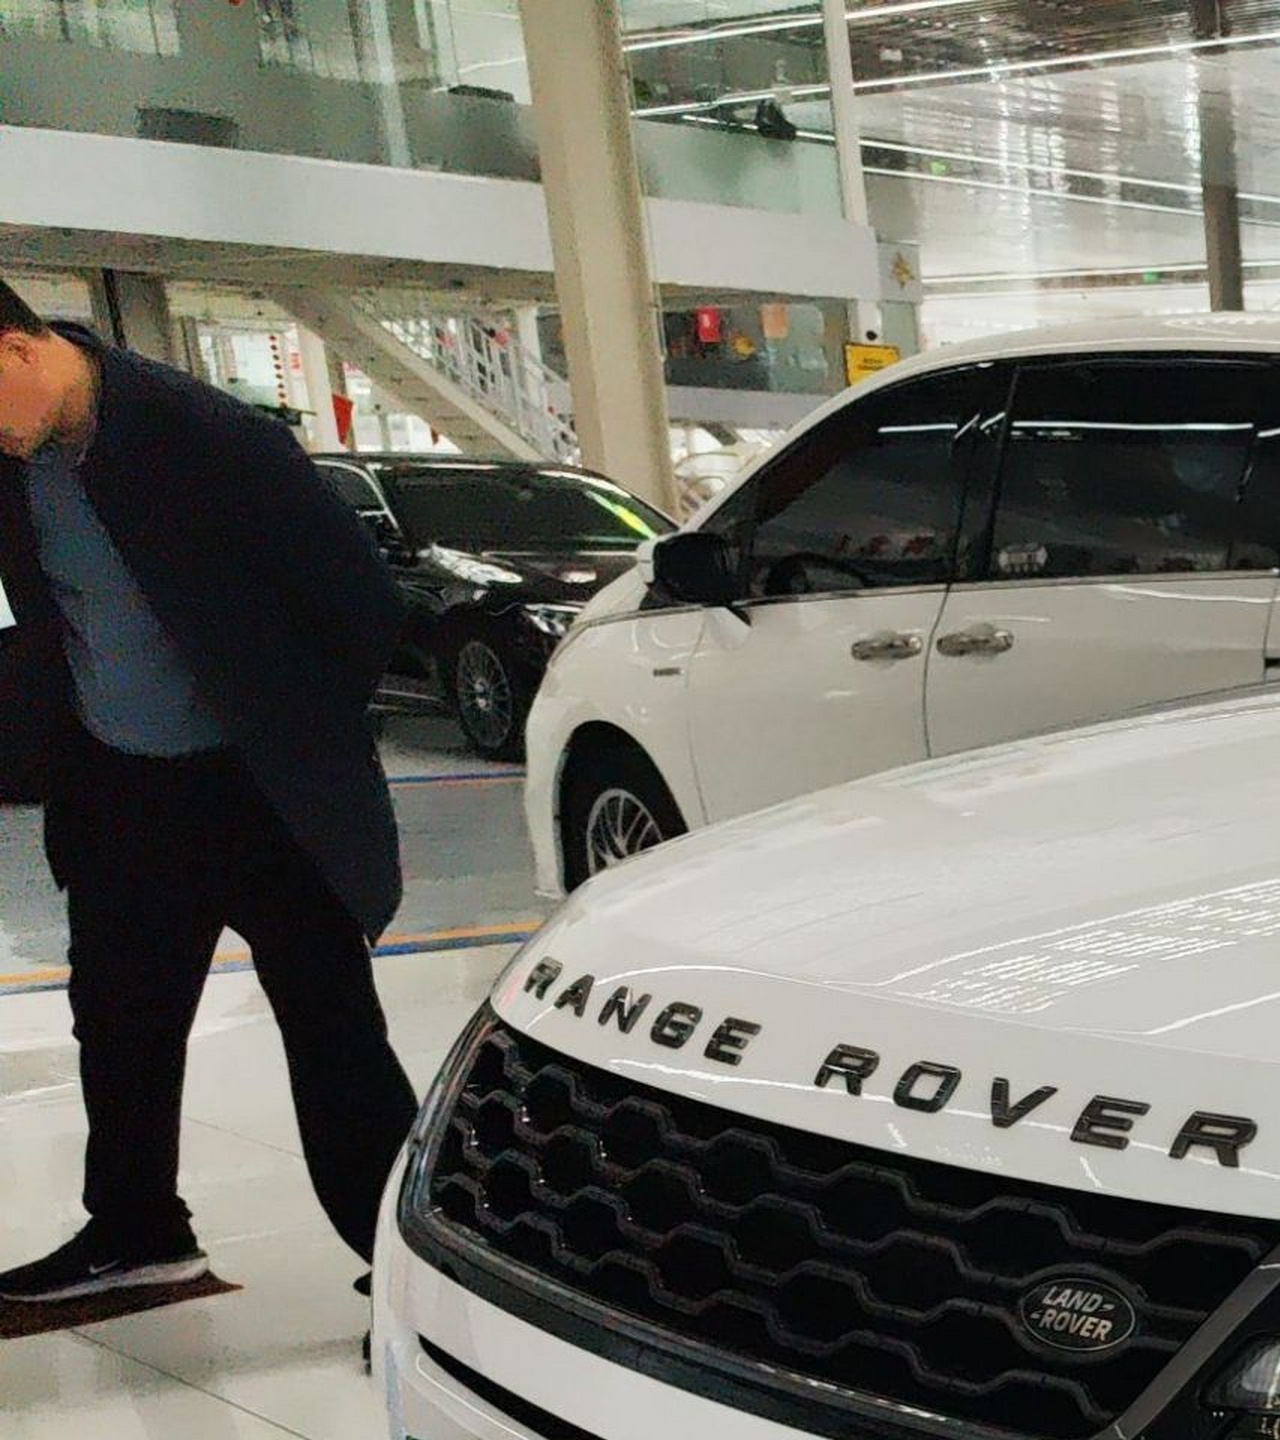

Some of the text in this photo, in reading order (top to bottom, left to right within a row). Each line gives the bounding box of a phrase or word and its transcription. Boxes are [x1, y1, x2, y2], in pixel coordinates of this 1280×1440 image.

[522, 956, 1258, 1169] RANGE ROVER
[1042, 1285, 1104, 1313] LAND
[1038, 1308, 1114, 1342] ROVER
